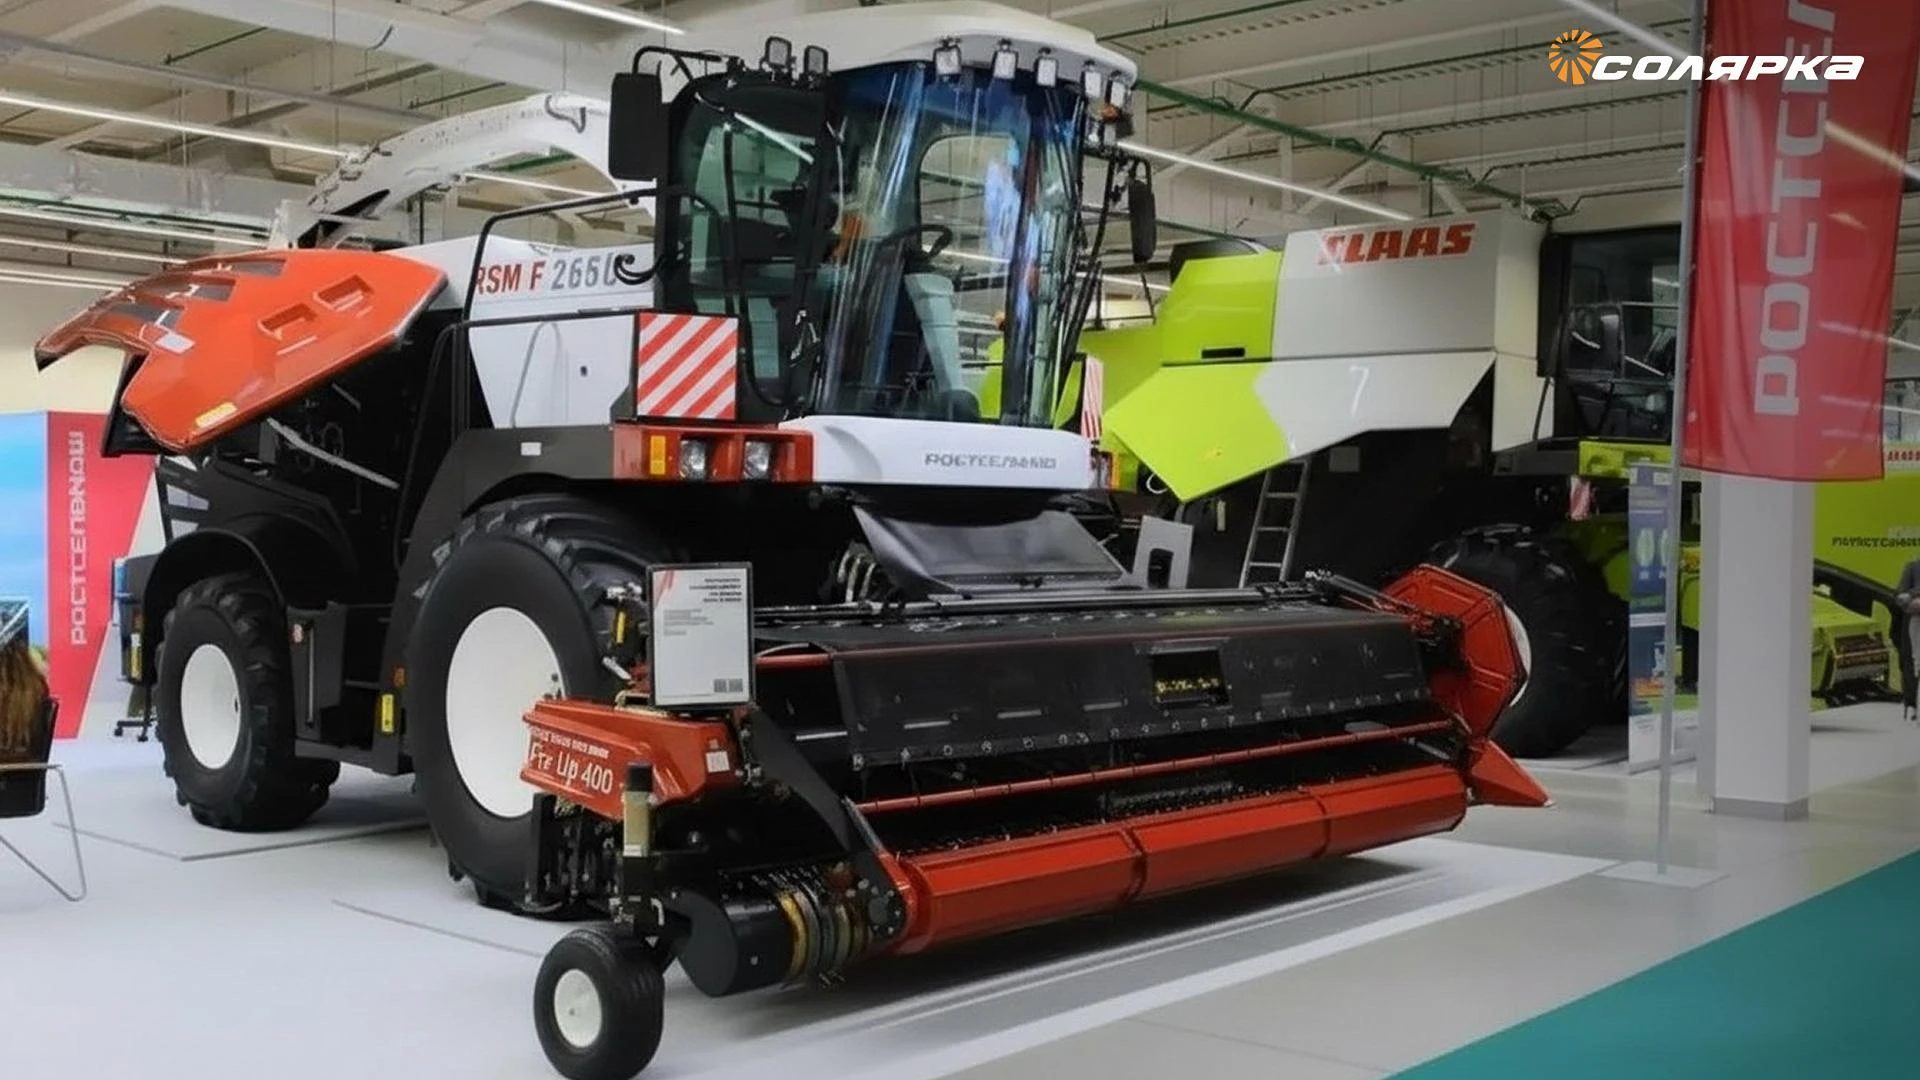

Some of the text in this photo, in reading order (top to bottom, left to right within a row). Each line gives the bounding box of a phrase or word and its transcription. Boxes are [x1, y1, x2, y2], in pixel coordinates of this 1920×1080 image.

[475, 263, 523, 294] RSM
[529, 260, 547, 290] F
[556, 751, 580, 787] Up
[581, 762, 614, 795] 400
